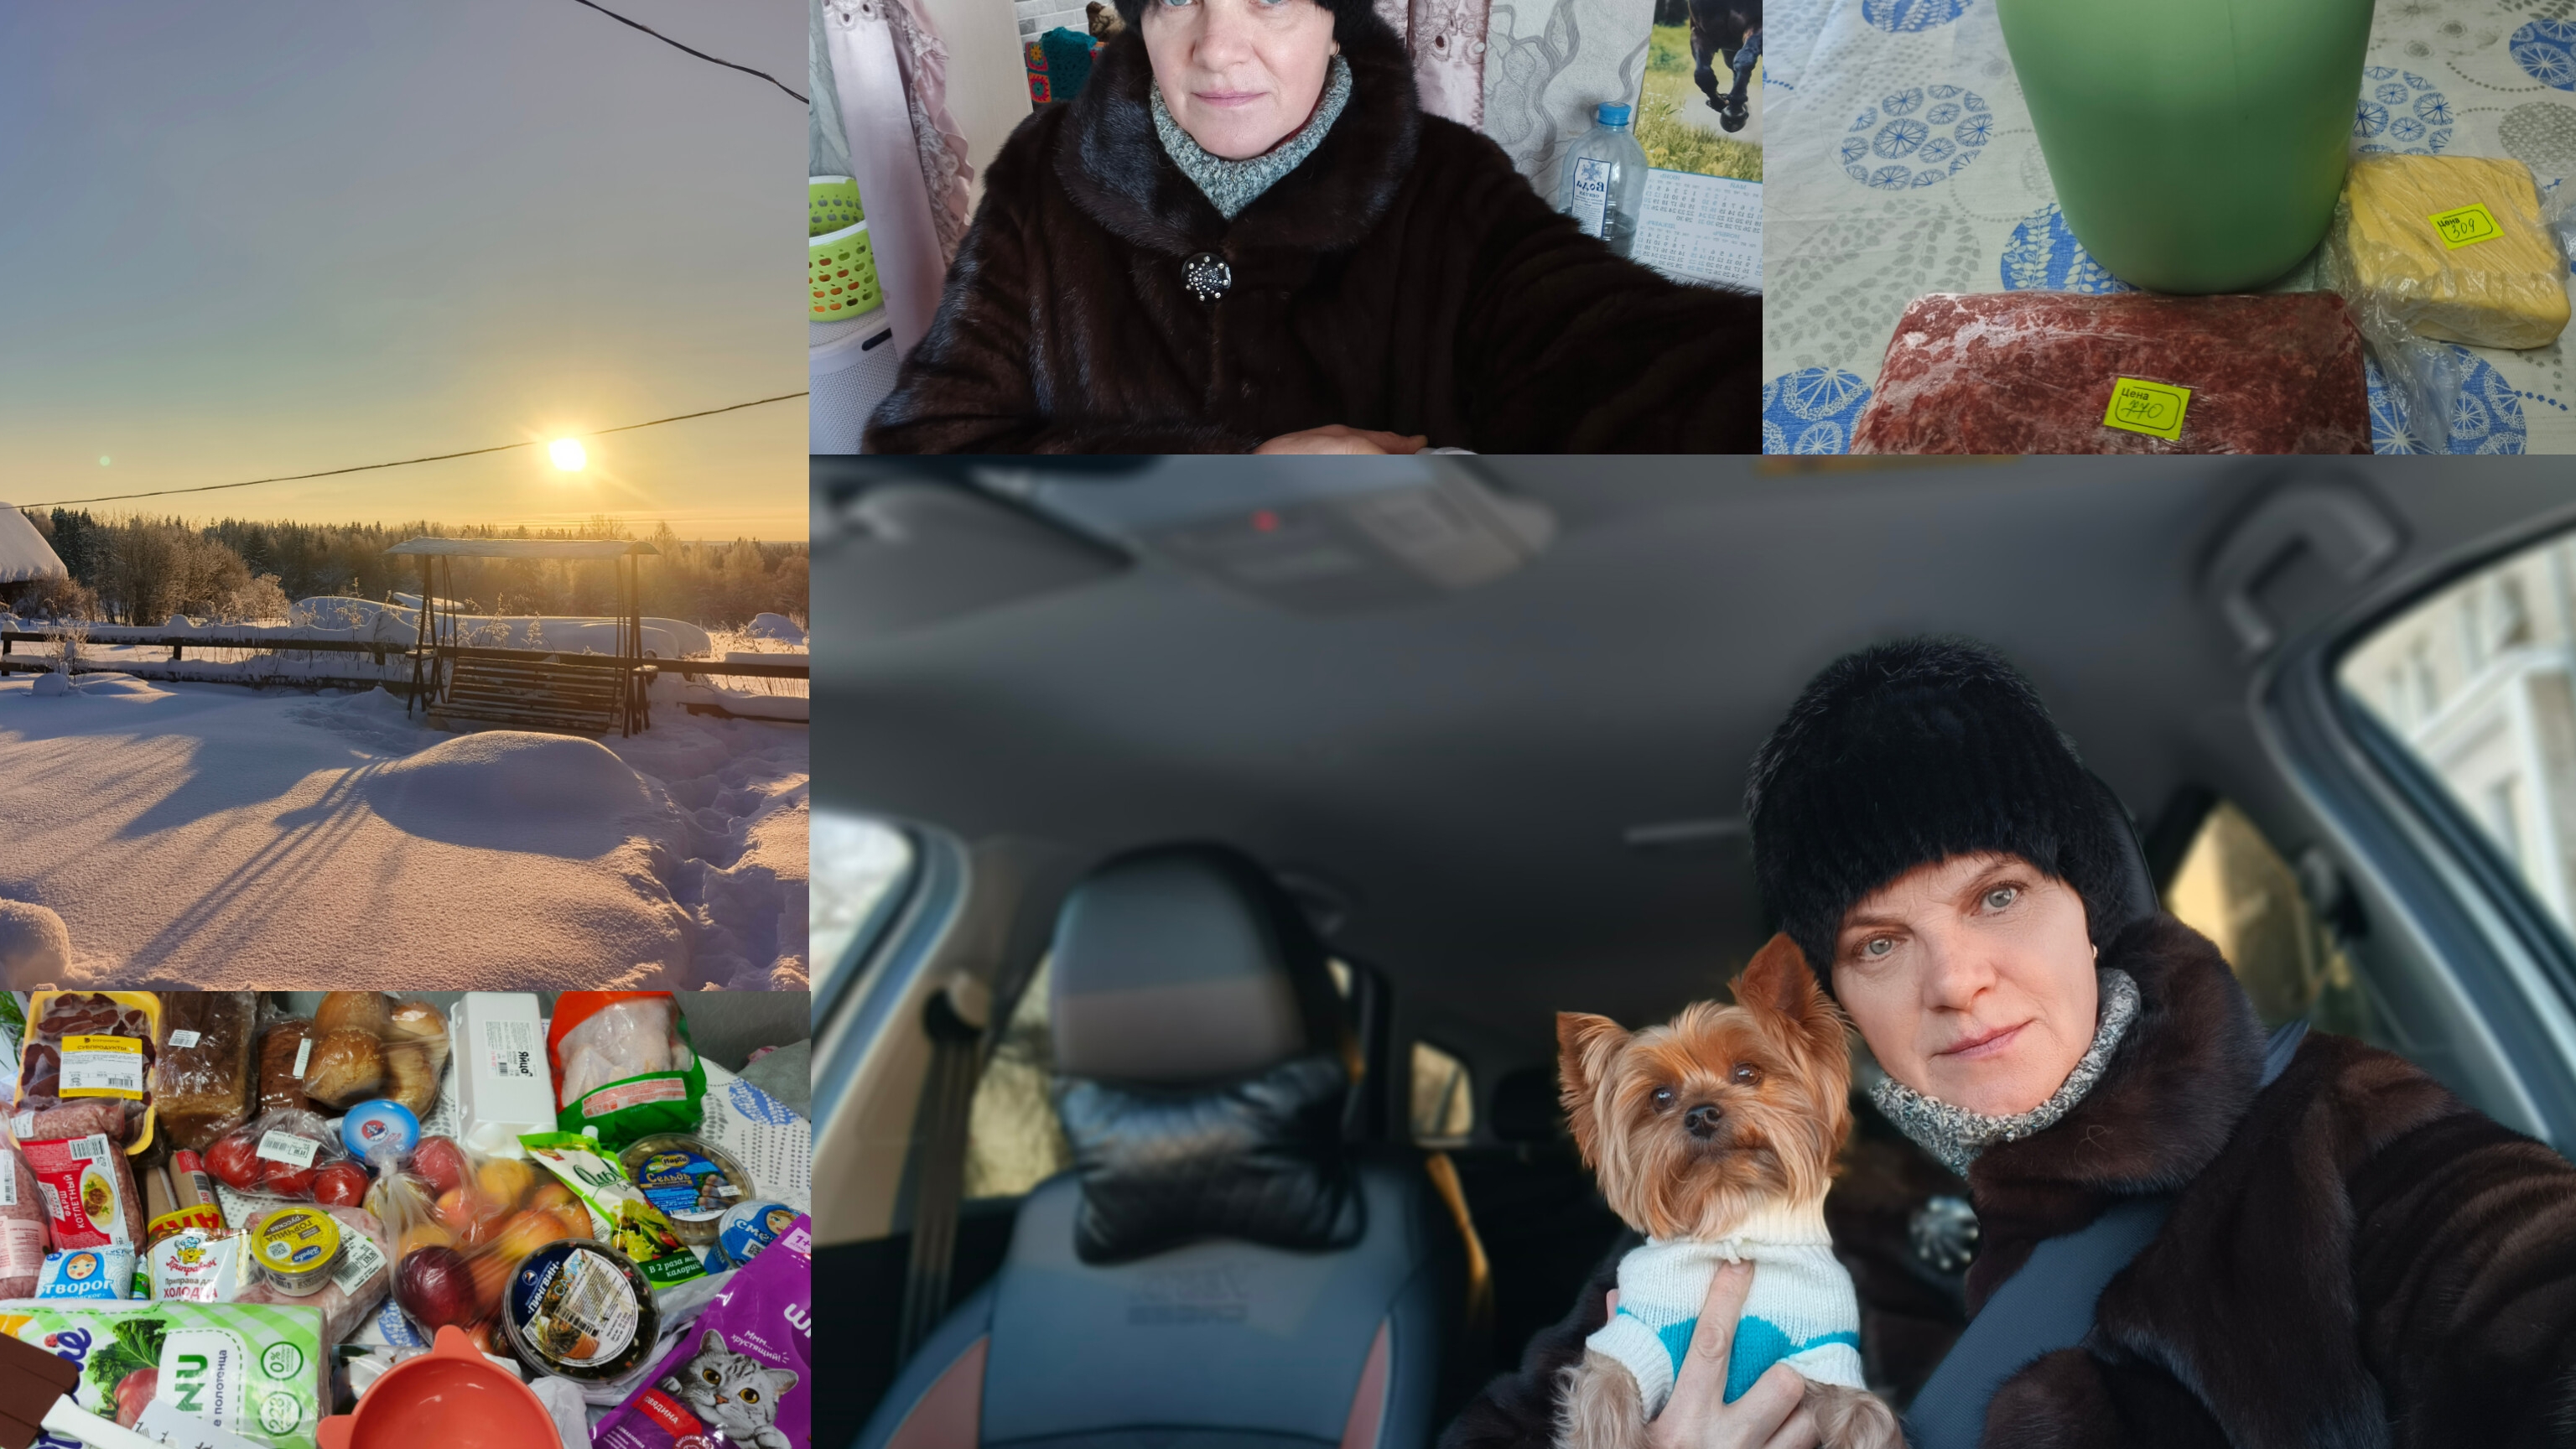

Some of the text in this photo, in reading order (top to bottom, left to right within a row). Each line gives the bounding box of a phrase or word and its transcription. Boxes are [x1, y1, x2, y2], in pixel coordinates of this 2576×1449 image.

[2437, 217, 2460, 228] Цена
[2452, 218, 2475, 239] 309
[2121, 387, 2149, 400] Цена
[646, 1172, 691, 1183] Сельдь
[60, 1191, 71, 1217] ФАРШ
[64, 1174, 85, 1228] КОТЛЕТНЫЙ
[266, 1220, 313, 1242] ГОРЧИЦА
[270, 1216, 301, 1232] русская
[735, 1219, 772, 1241] сме
[294, 1246, 319, 1261] Здрава
[553, 1254, 584, 1296] САЛАТ
[648, 1265, 656, 1274] В
[657, 1263, 663, 1271] 2
[664, 1259, 683, 1271] раза
[165, 1278, 199, 1286] Приправа
[164, 1286, 218, 1300] ХОЛОДА
[730, 1333, 782, 1363] хрустящий!
[745, 1330, 773, 1350] Ммм...
[270, 1351, 284, 1373] 0%
[175, 1354, 208, 1418] NU
[215, 1349, 228, 1415] полотенца
[269, 1396, 284, 1431] 228
